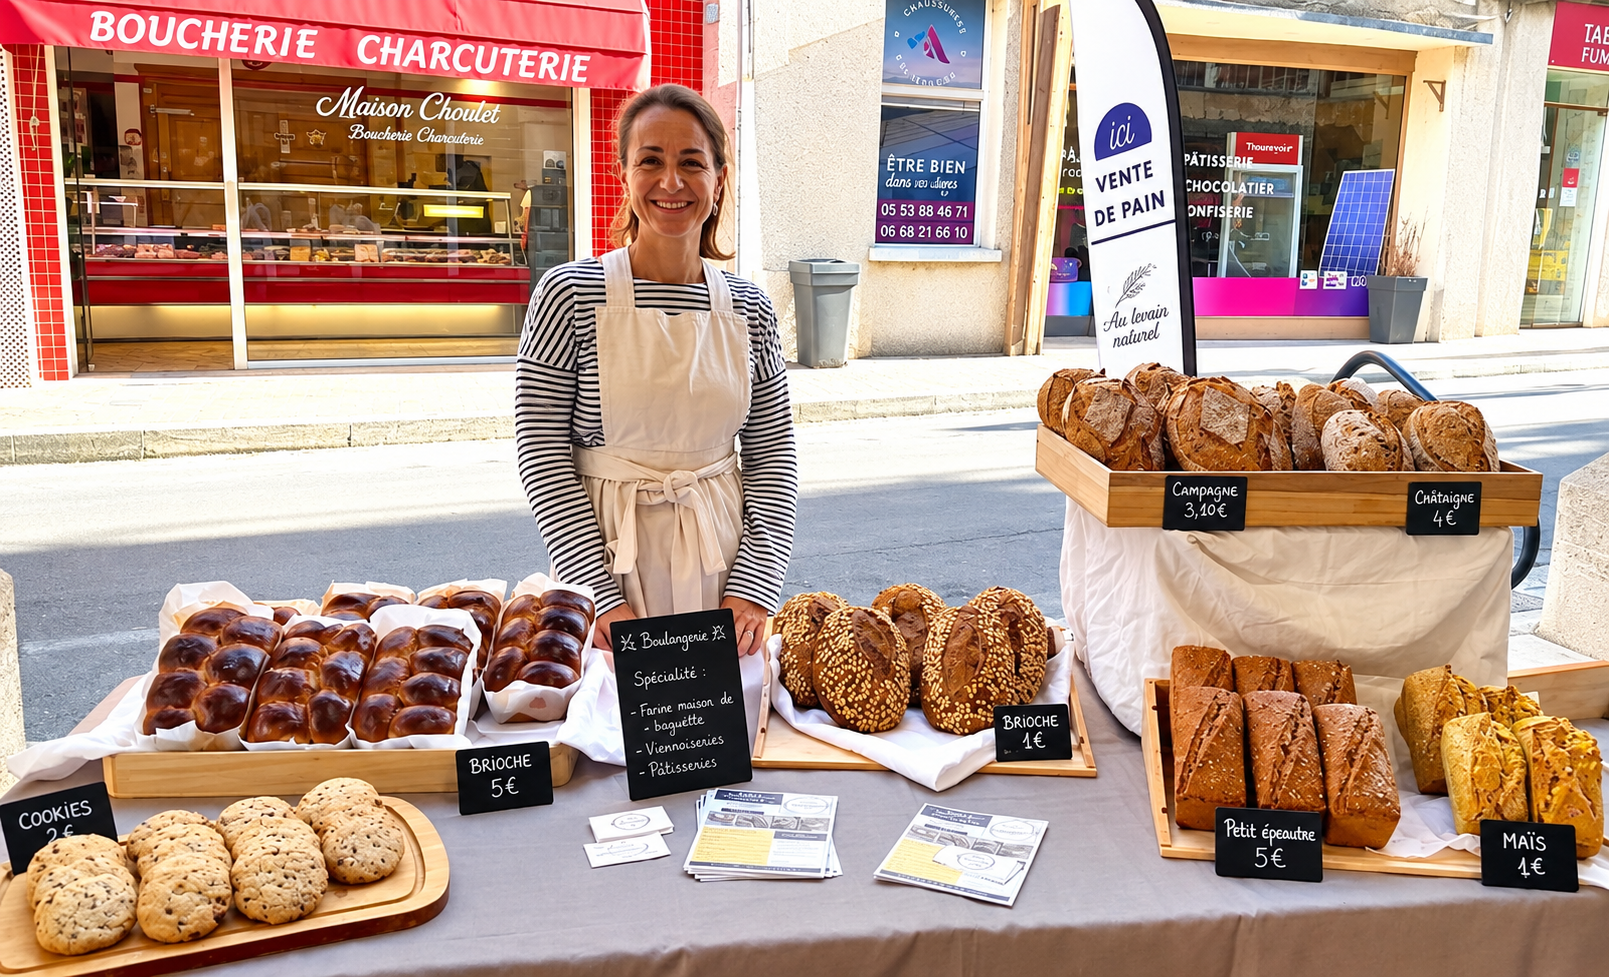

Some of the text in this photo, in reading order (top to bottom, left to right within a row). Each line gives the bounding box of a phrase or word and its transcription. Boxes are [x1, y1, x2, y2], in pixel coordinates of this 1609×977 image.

[89, 10, 591, 84] BOUCHERIE CHARCUTERIE
[1581, 47, 1609, 65] FUM
[315, 86, 501, 124] Maison Choulet
[348, 123, 485, 146] Boucherie Charcuterie
[1109, 115, 1135, 150] ici
[887, 153, 966, 174] ÊTRE BIEN
[1095, 160, 1153, 193] VENTE
[1185, 179, 1274, 195] CHOCOLATIER
[881, 203, 968, 218] 05 53 88 46 71
[1094, 190, 1165, 227] DE PAIN
[1188, 205, 1254, 219] ONFISERIE
[880, 225, 968, 239] 06 68 21 66 10
[1103, 306, 1169, 332] Au levain
[1112, 322, 1160, 348] naturel
[1184, 502, 1228, 520] 3,10€
[639, 630, 709, 652] Boulangerie
[634, 666, 698, 690] Spécialité
[640, 691, 734, 717] Farine maison de
[645, 734, 725, 755] Viennoiseries
[1022, 731, 1046, 750] 1€
[490, 776, 519, 798] 5€
[1223, 818, 1316, 846] Petit épeautre
[1503, 831, 1547, 852] MAÏS
[1254, 847, 1287, 868] 5€
[1517, 856, 1546, 879] 1€
